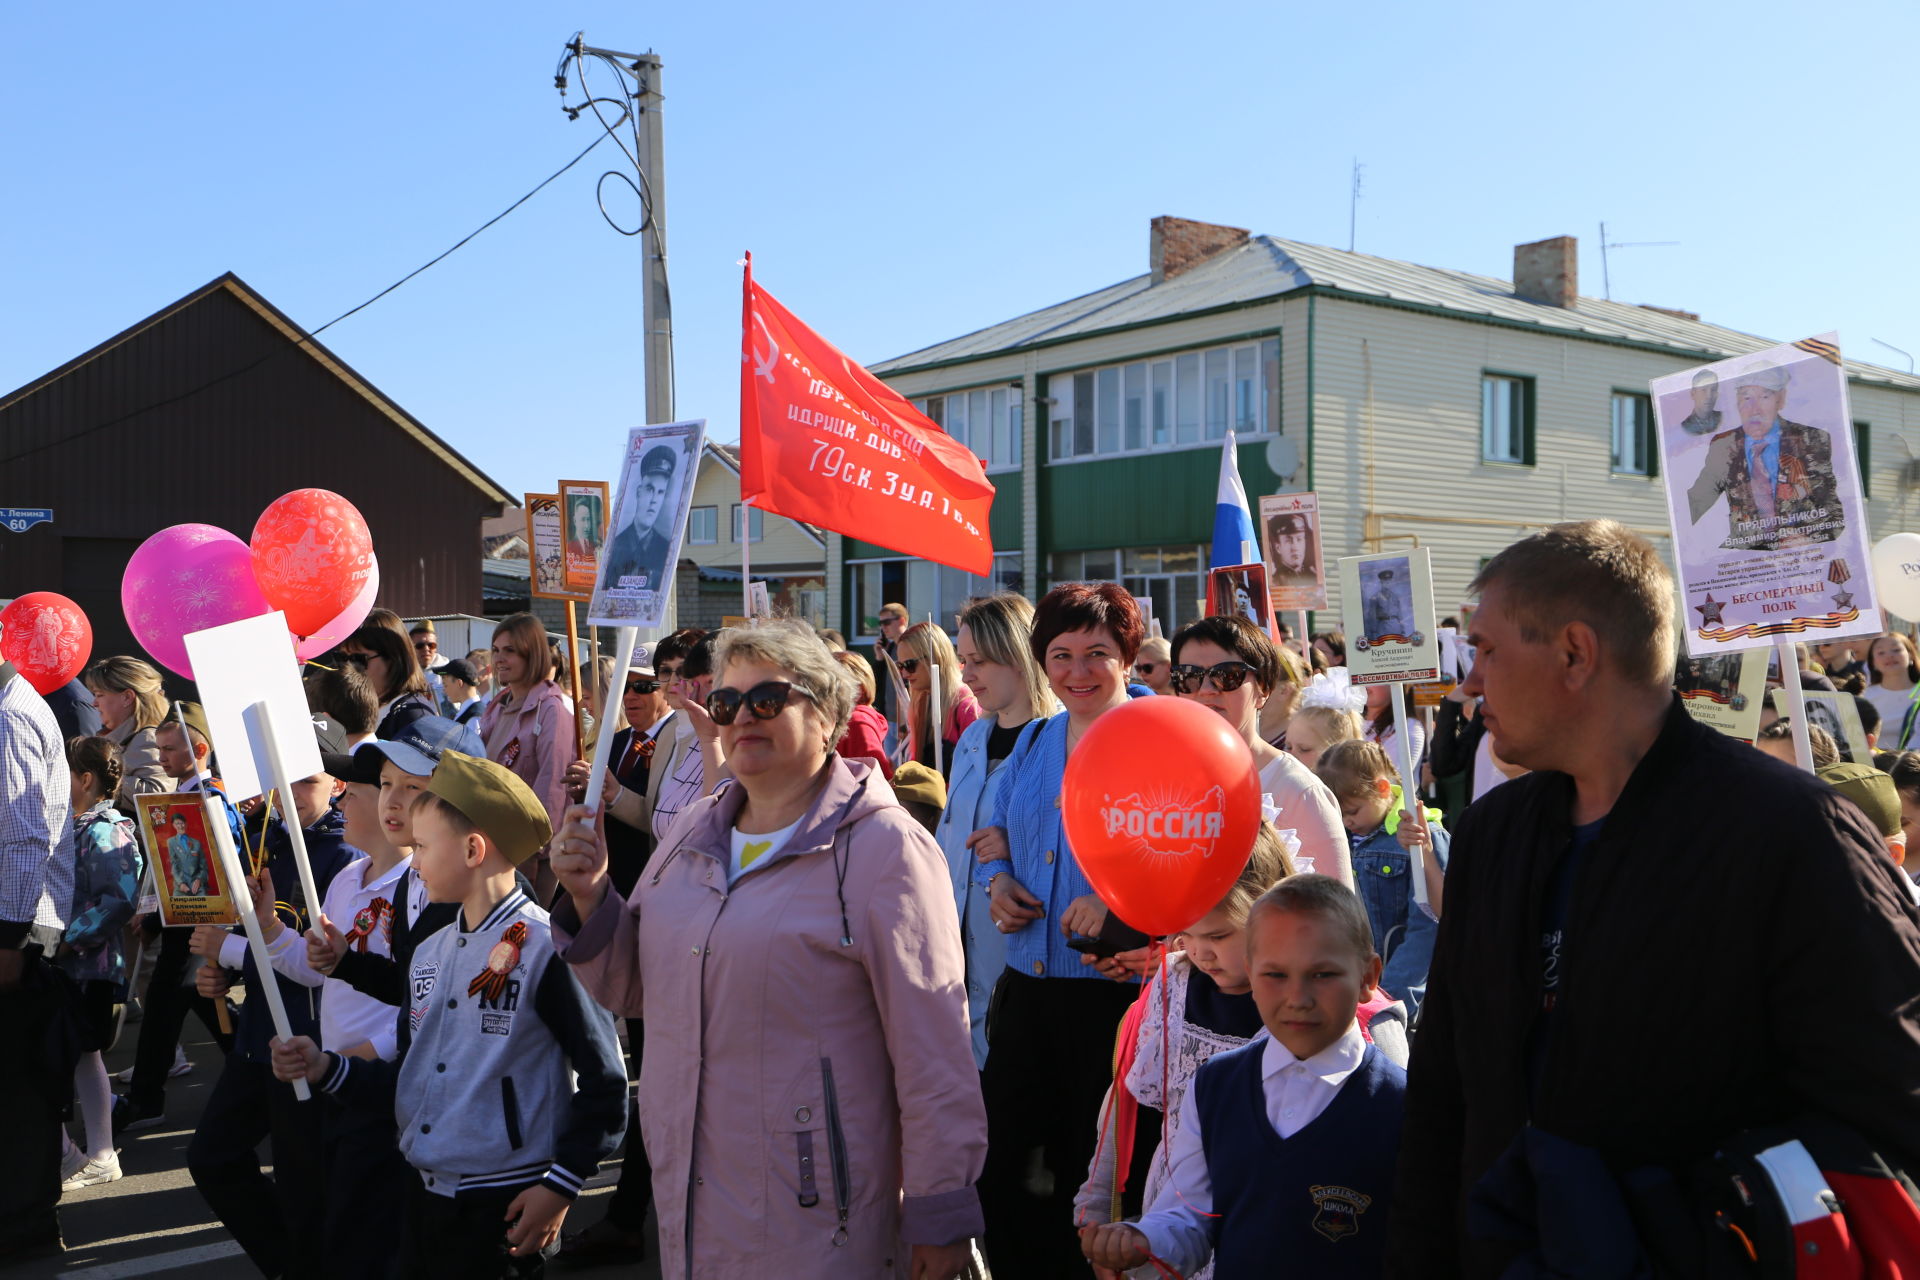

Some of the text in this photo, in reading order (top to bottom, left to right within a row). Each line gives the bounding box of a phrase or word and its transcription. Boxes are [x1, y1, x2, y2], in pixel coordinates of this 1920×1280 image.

[788, 404, 906, 462] ИДРИЦК. ДИВ.
[809, 439, 844, 477] 79
[9, 510, 44, 518] Ленина
[1738, 508, 1827, 532] ПРЯДИЛЬНИКОВ
[10, 519, 26, 530] 60
[1725, 531, 1776, 546] Владимир
[1779, 520, 1845, 538] Дмитриевич
[1732, 582, 1825, 604] БЕССМЕРТНЫЙ
[1762, 600, 1797, 614] ПОЛК
[1371, 648, 1413, 657] Кручинин
[1359, 670, 1430, 682] Бессмертный полк
[1684, 701, 1722, 712] Миронов
[411, 736, 434, 751] CLASSIC
[1108, 807, 1222, 839] РОССИЯ
[415, 978, 434, 997] 03
[1324, 1201, 1354, 1215] ШКОЛА
